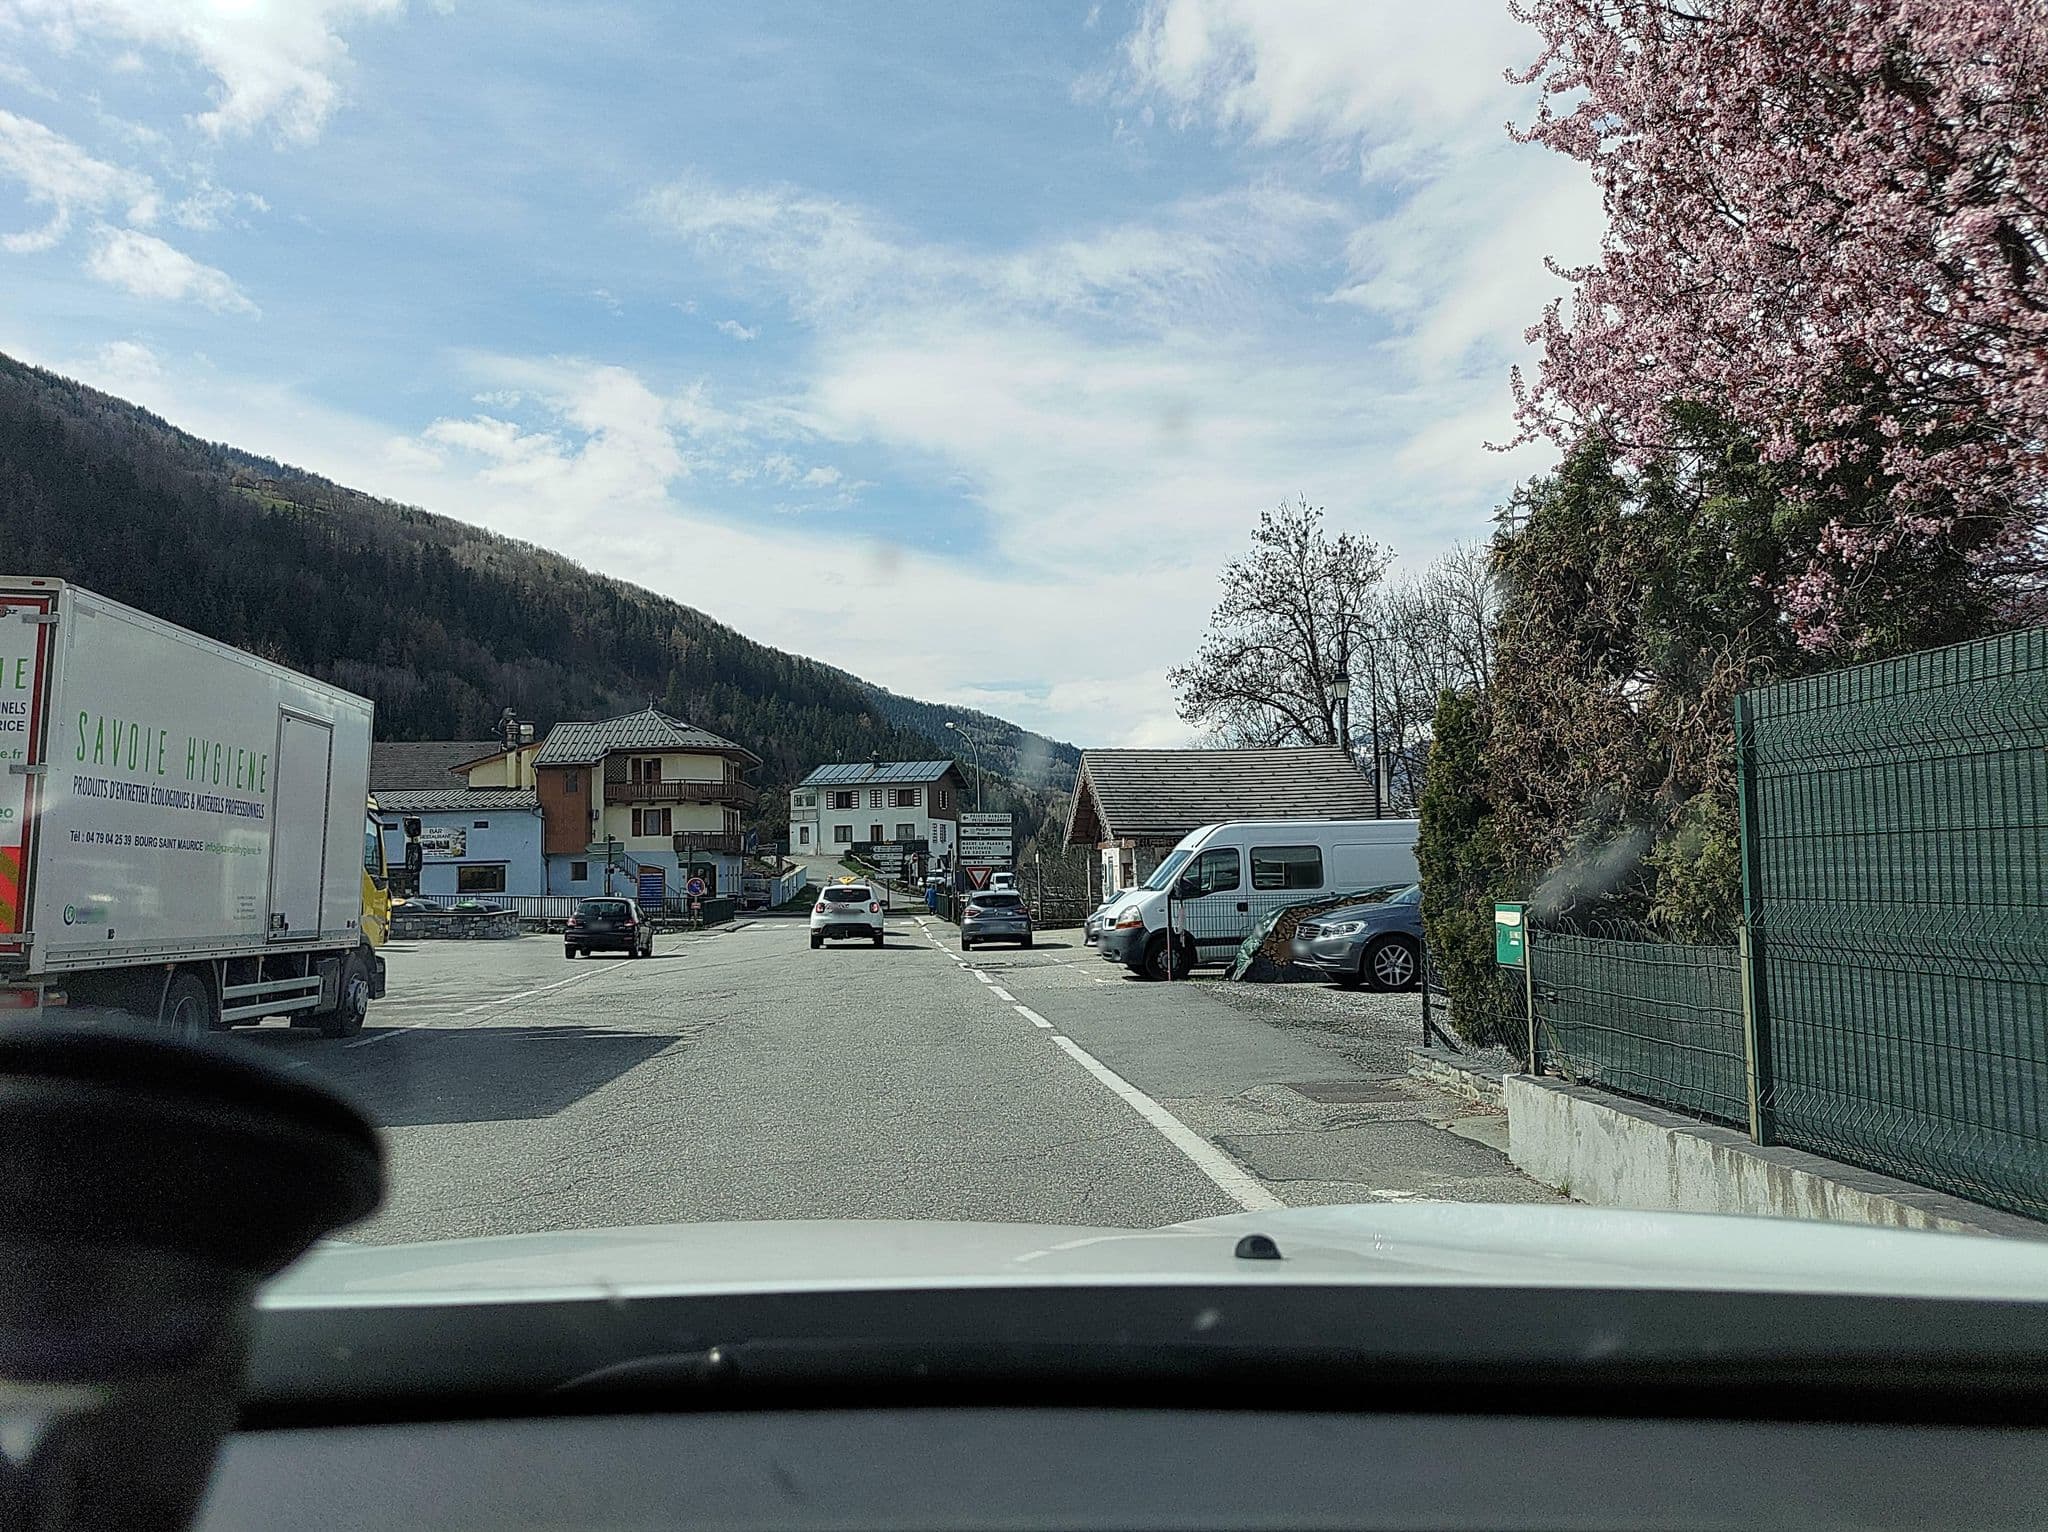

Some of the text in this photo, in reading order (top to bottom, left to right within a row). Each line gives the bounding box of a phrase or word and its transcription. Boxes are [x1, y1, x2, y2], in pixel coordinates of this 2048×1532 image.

[76, 711, 268, 793] SAVOIE HYGIENE
[73, 775, 265, 819] PRODUITS D'ENTRETIEN ÉCOLOGIQUES & MATÉRIELS PROFESSIONNELS
[86, 832, 94, 843] 04
[96, 832, 104, 844] 79
[105, 833, 113, 844] 04
[115, 834, 123, 845] 25
[124, 834, 132, 846] 39
[134, 836, 158, 848] BOURG
[159, 838, 176, 849] SAINT
[177, 839, 204, 851] MAURICE
